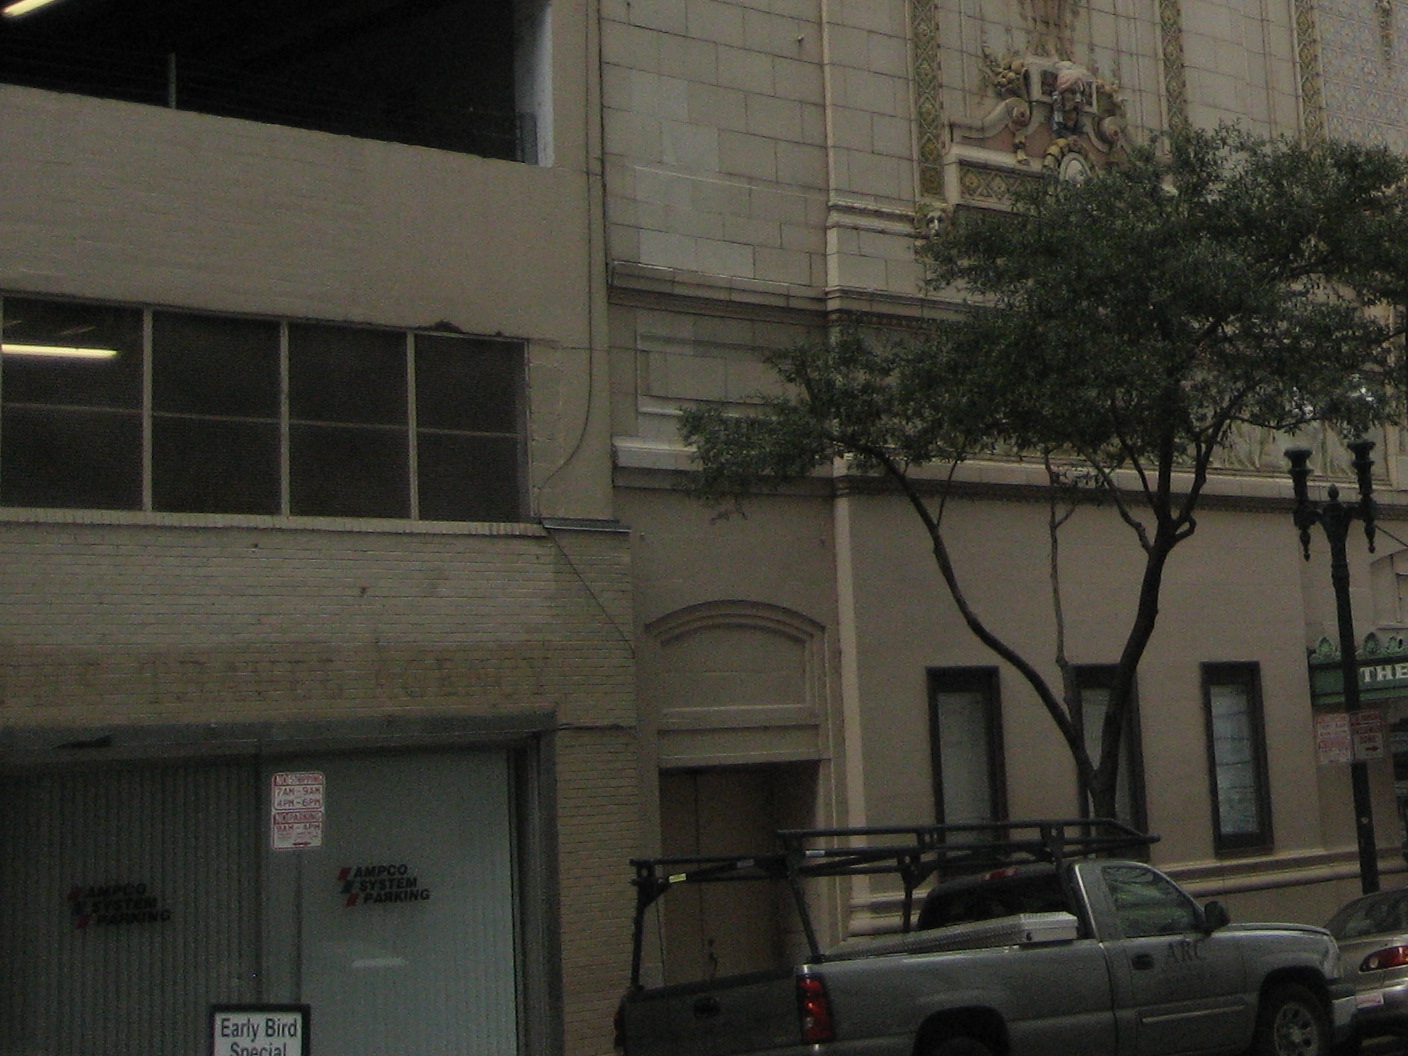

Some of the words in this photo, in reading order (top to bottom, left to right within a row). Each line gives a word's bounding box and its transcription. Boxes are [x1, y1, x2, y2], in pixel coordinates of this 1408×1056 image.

[354, 864, 408, 878] AMPCO
[84, 882, 147, 897] AMPCO
[360, 877, 418, 892] SYSTEM
[364, 889, 431, 904] PARKING
[91, 896, 158, 913] SYSTEM
[96, 909, 172, 925] PARKING
[221, 1017, 259, 1042] Early
[265, 1018, 297, 1038] Bird
